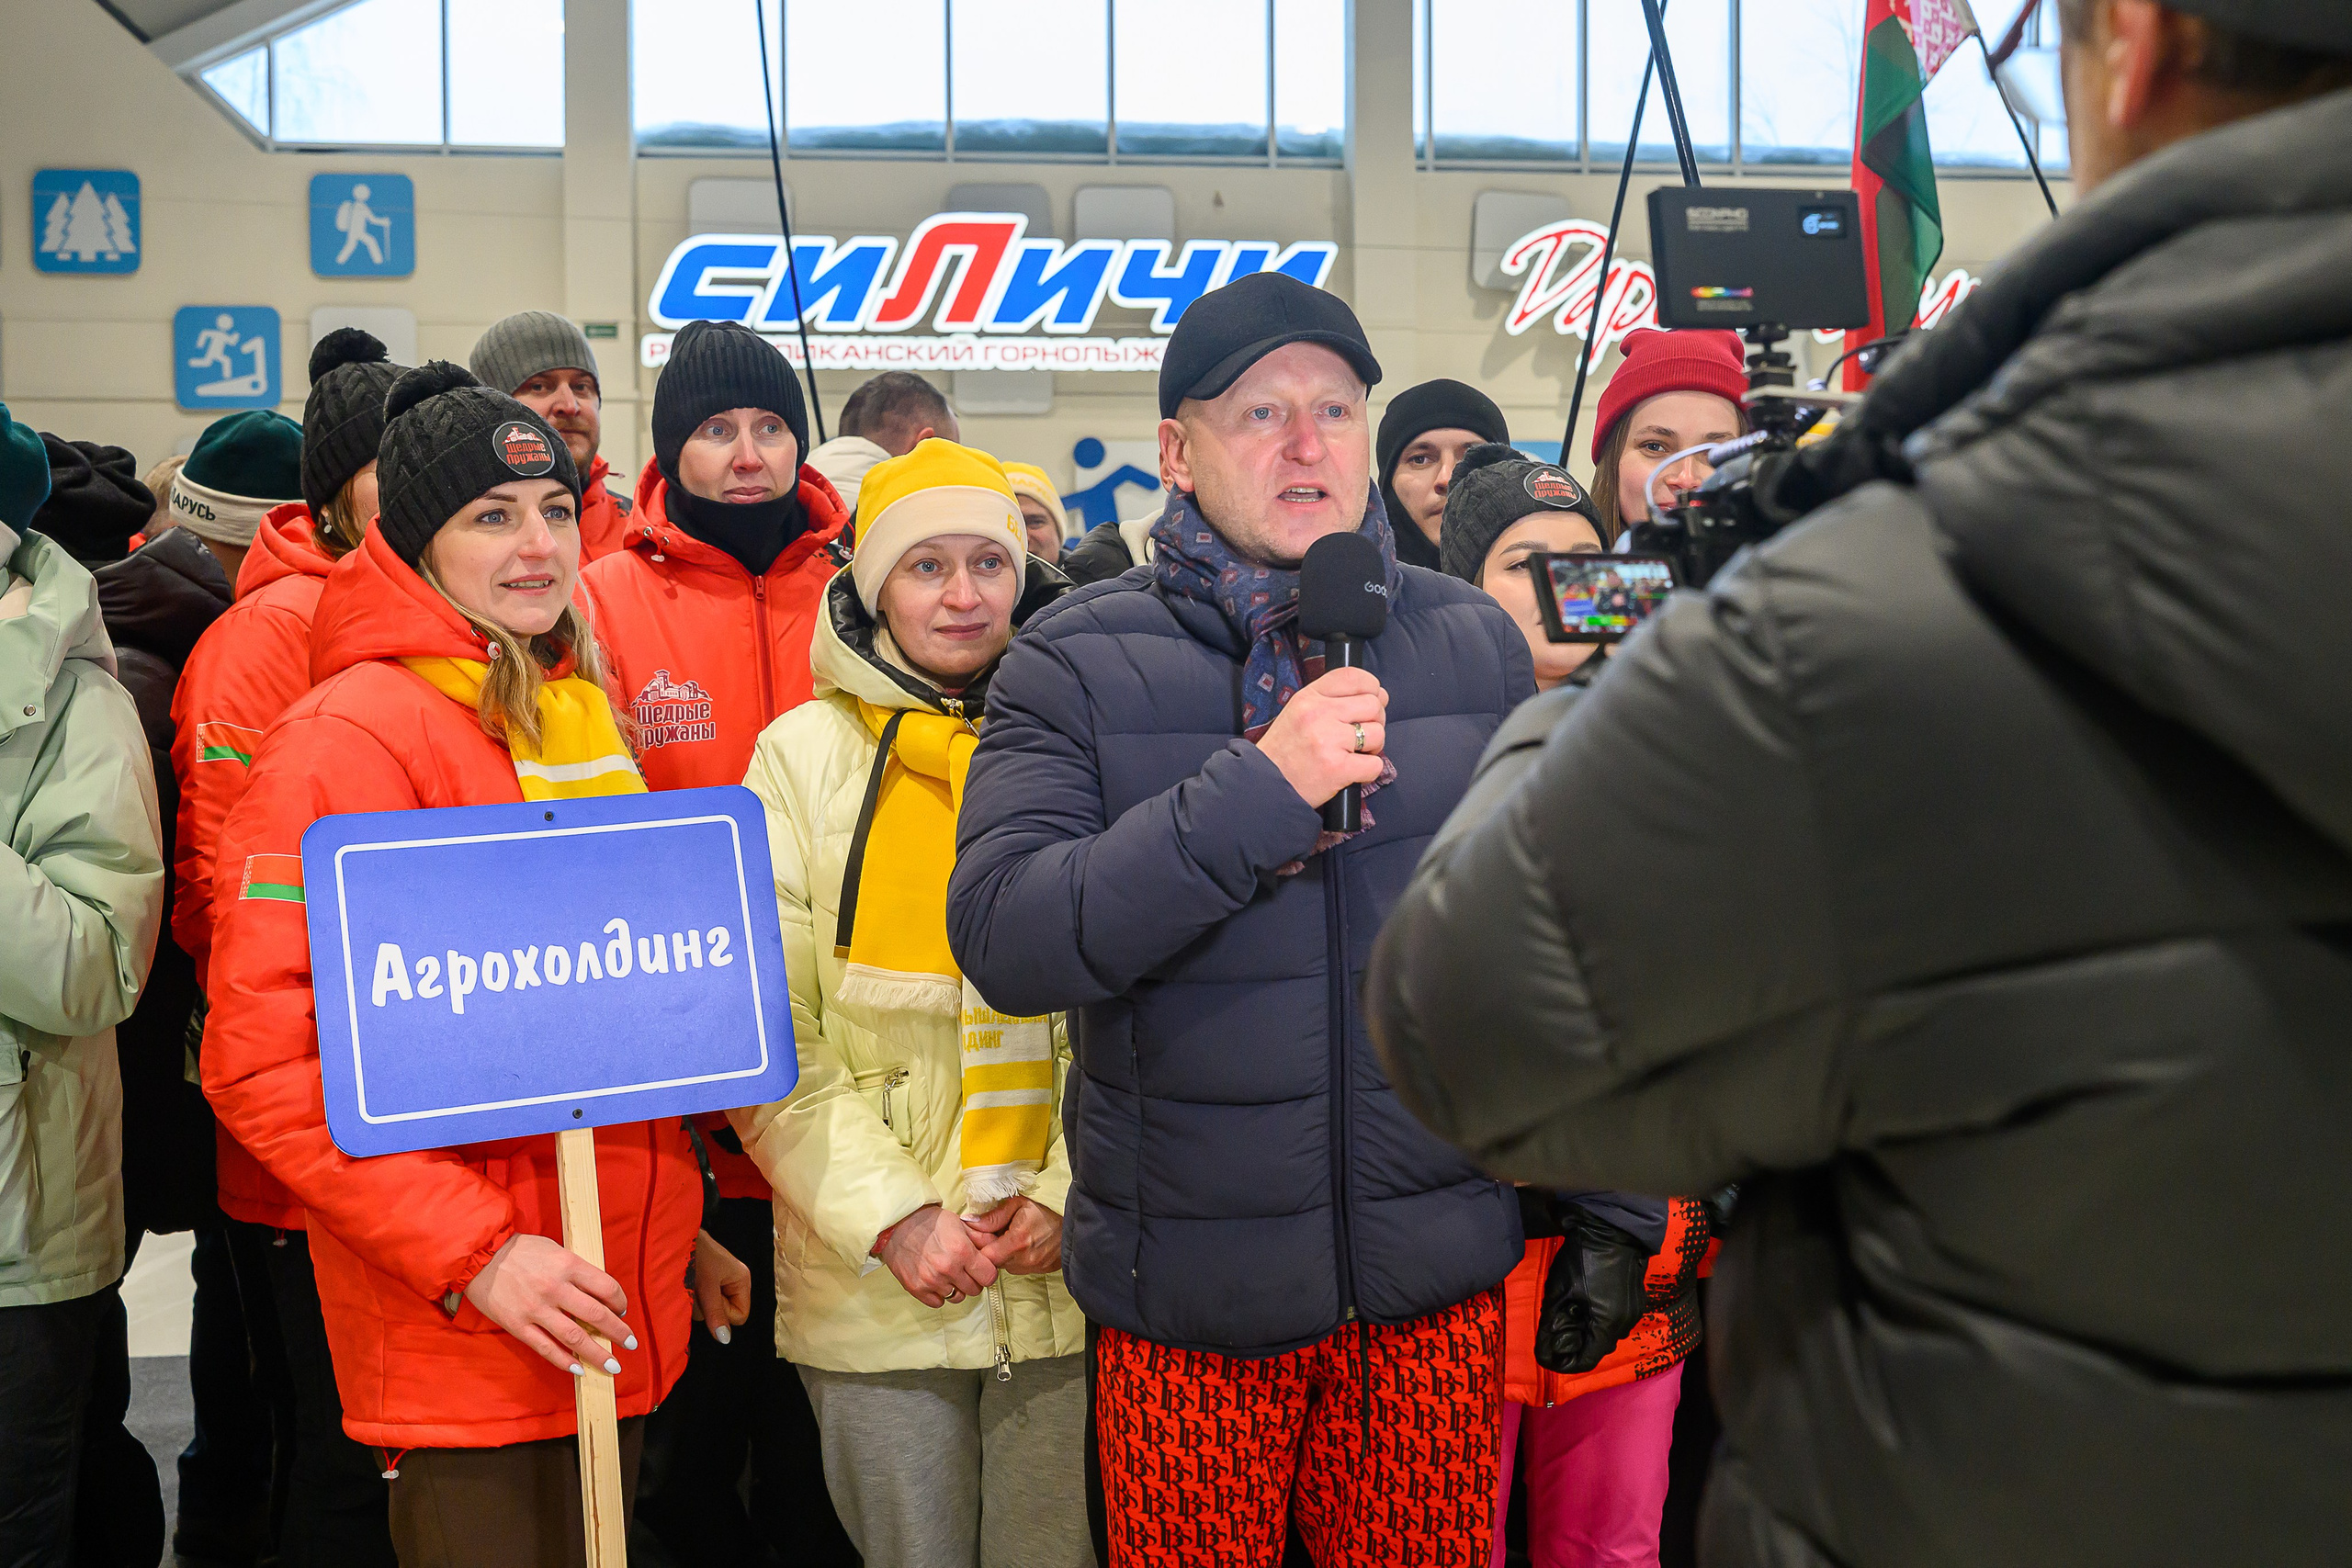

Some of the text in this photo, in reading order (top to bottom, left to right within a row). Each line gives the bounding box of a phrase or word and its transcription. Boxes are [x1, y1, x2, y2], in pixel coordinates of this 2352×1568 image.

[650, 340, 1161, 364] РЛИКАНСКИЙ ГОРНОЛЫЖ
[505, 442, 547, 454] Щедрые
[505, 453, 552, 465] Пружаны
[636, 702, 712, 727] Щедрые
[642, 722, 716, 750] ружаны
[371, 918, 733, 1014] Агрохолдинг
